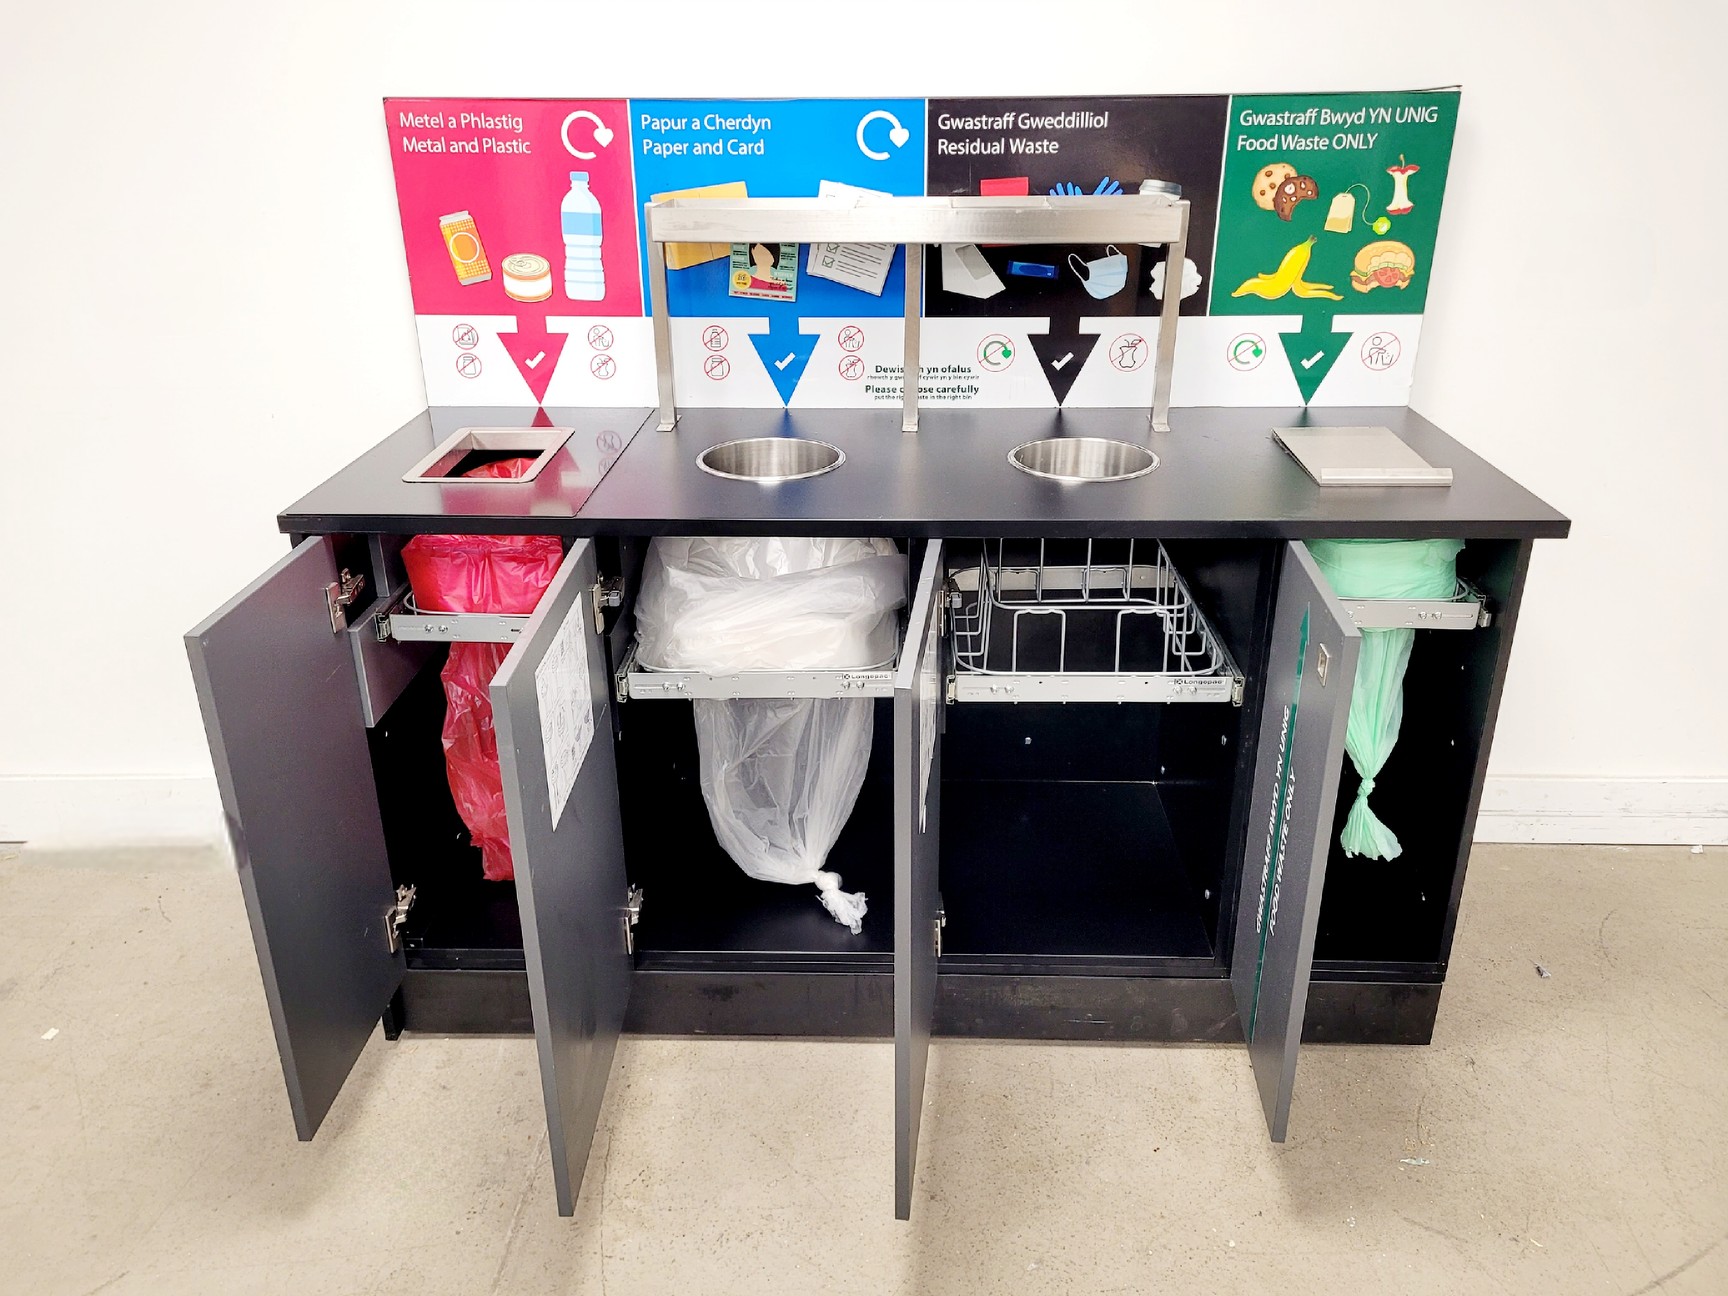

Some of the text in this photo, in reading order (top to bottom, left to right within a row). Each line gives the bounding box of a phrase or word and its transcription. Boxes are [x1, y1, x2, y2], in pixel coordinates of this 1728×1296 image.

[399, 111, 524, 134] Metel a Phlastig
[641, 113, 772, 135] Papur a Cherdyn
[937, 111, 1109, 130] Gwastraff Gweddilliol
[1239, 106, 1439, 129] Gwastraff Bwyd YN UNIG
[402, 136, 532, 154] Metal and Plastic
[643, 138, 765, 159] Paper and Card
[937, 138, 1060, 156] Residual Waste
[1236, 132, 1379, 151] Food Waste ONLY
[926, 366, 939, 375] yn
[941, 364, 972, 373] ofalus
[865, 384, 979, 395] Please cose carefully
[1256, 704, 1289, 934] GWASTRAFF BWYD YN UNIG
[1269, 766, 1296, 937] FOOD WASTE ONLY
